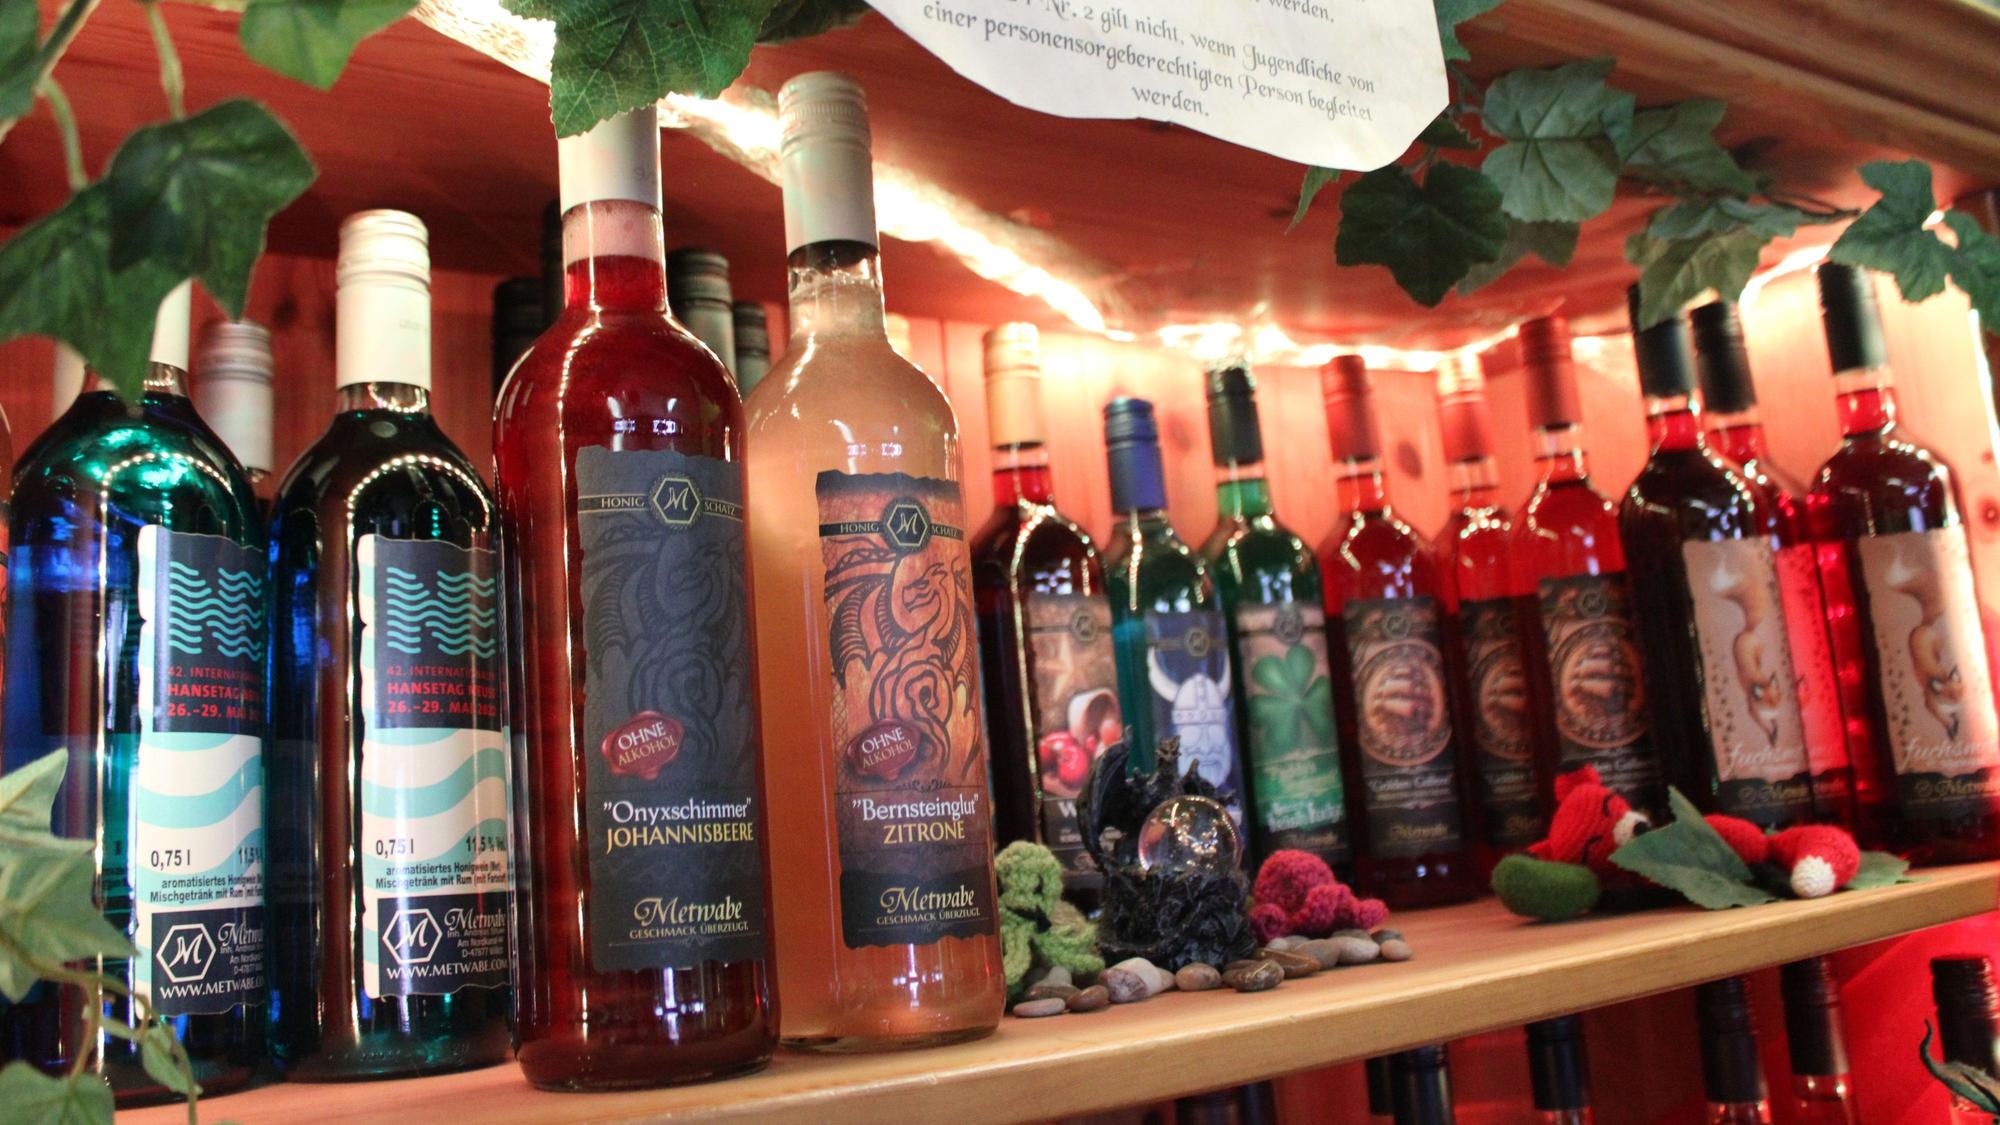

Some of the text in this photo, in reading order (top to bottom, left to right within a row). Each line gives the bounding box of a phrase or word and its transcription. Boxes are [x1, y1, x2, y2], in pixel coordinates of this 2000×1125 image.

[1083, 5, 1095, 21] 2
[1100, 6, 1128, 34] gilt
[1136, 17, 1185, 46] nicht,
[1190, 32, 1236, 58] wenn
[1242, 43, 1342, 86] Jugendliche
[1347, 74, 1375, 93] von
[923, 1, 1374, 122] einer personensorgeberechtigten Person begleitet
[1131, 85, 1210, 117] werden.
[601, 496, 645, 508] HONIG
[704, 500, 736, 516] SCHATZ
[840, 522, 880, 534] HONIG
[931, 524, 958, 538] SCHATZ
[167, 682, 240, 700] HANSETAG
[387, 682, 465, 696] HANSETAG
[617, 721, 667, 750] OHNE
[861, 726, 905, 754] OHNE
[617, 734, 678, 767] ALKOHOL
[861, 738, 916, 770] ALKOHOL
[606, 821, 755, 855] JOHANNISBEERE
[883, 820, 966, 845] ZITRONE
[151, 849, 182, 871] 0,75
[375, 838, 406, 859] 0,75
[161, 875, 227, 889] aromatisiertes
[375, 874, 438, 890] Miscgetränk
[440, 875, 454, 886] mit
[456, 874, 472, 885] Rum
[633, 895, 743, 927] Metwabe
[879, 884, 976, 915] Metwabe
[876, 911, 937, 926] GESCHMACK
[457, 939, 470, 948] Am
[629, 925, 697, 940] GESCHMACK
